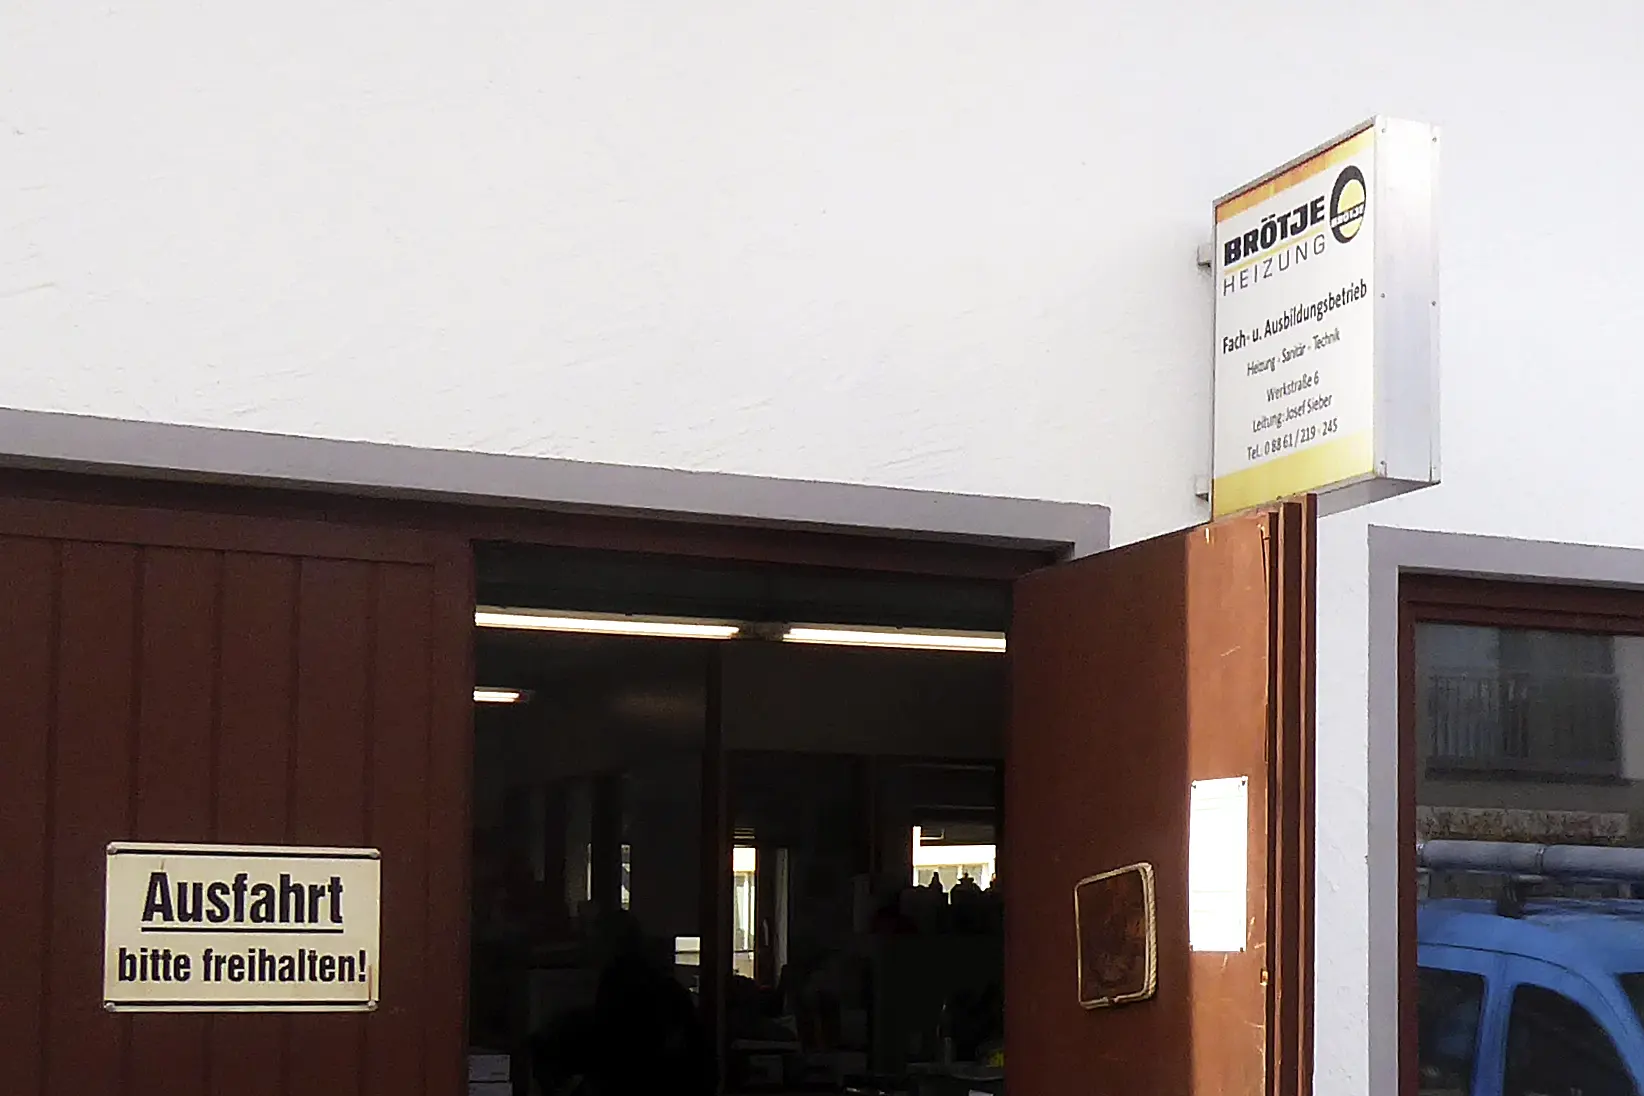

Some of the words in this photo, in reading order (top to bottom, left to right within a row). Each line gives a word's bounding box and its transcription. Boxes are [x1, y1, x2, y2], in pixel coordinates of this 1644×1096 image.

[1223, 195, 1325, 267] BRÖTJE
[1223, 233, 1326, 297] HEIZUNG
[1252, 328, 1262, 343] u.
[1264, 278, 1368, 339] Ausbildungsbetrieb
[1246, 355, 1276, 377] Heizung
[1281, 342, 1306, 364] Sanitär
[1312, 327, 1341, 351] Technik
[1266, 373, 1312, 402] Werkstraße
[1313, 370, 1319, 385] 6
[1252, 412, 1285, 433] Leitung:
[1285, 399, 1306, 422] Josef
[1247, 443, 1262, 461] Tel.
[141, 871, 344, 924] Ausfahrt
[118, 947, 191, 982] bitte
[203, 948, 367, 982] freihalten!
